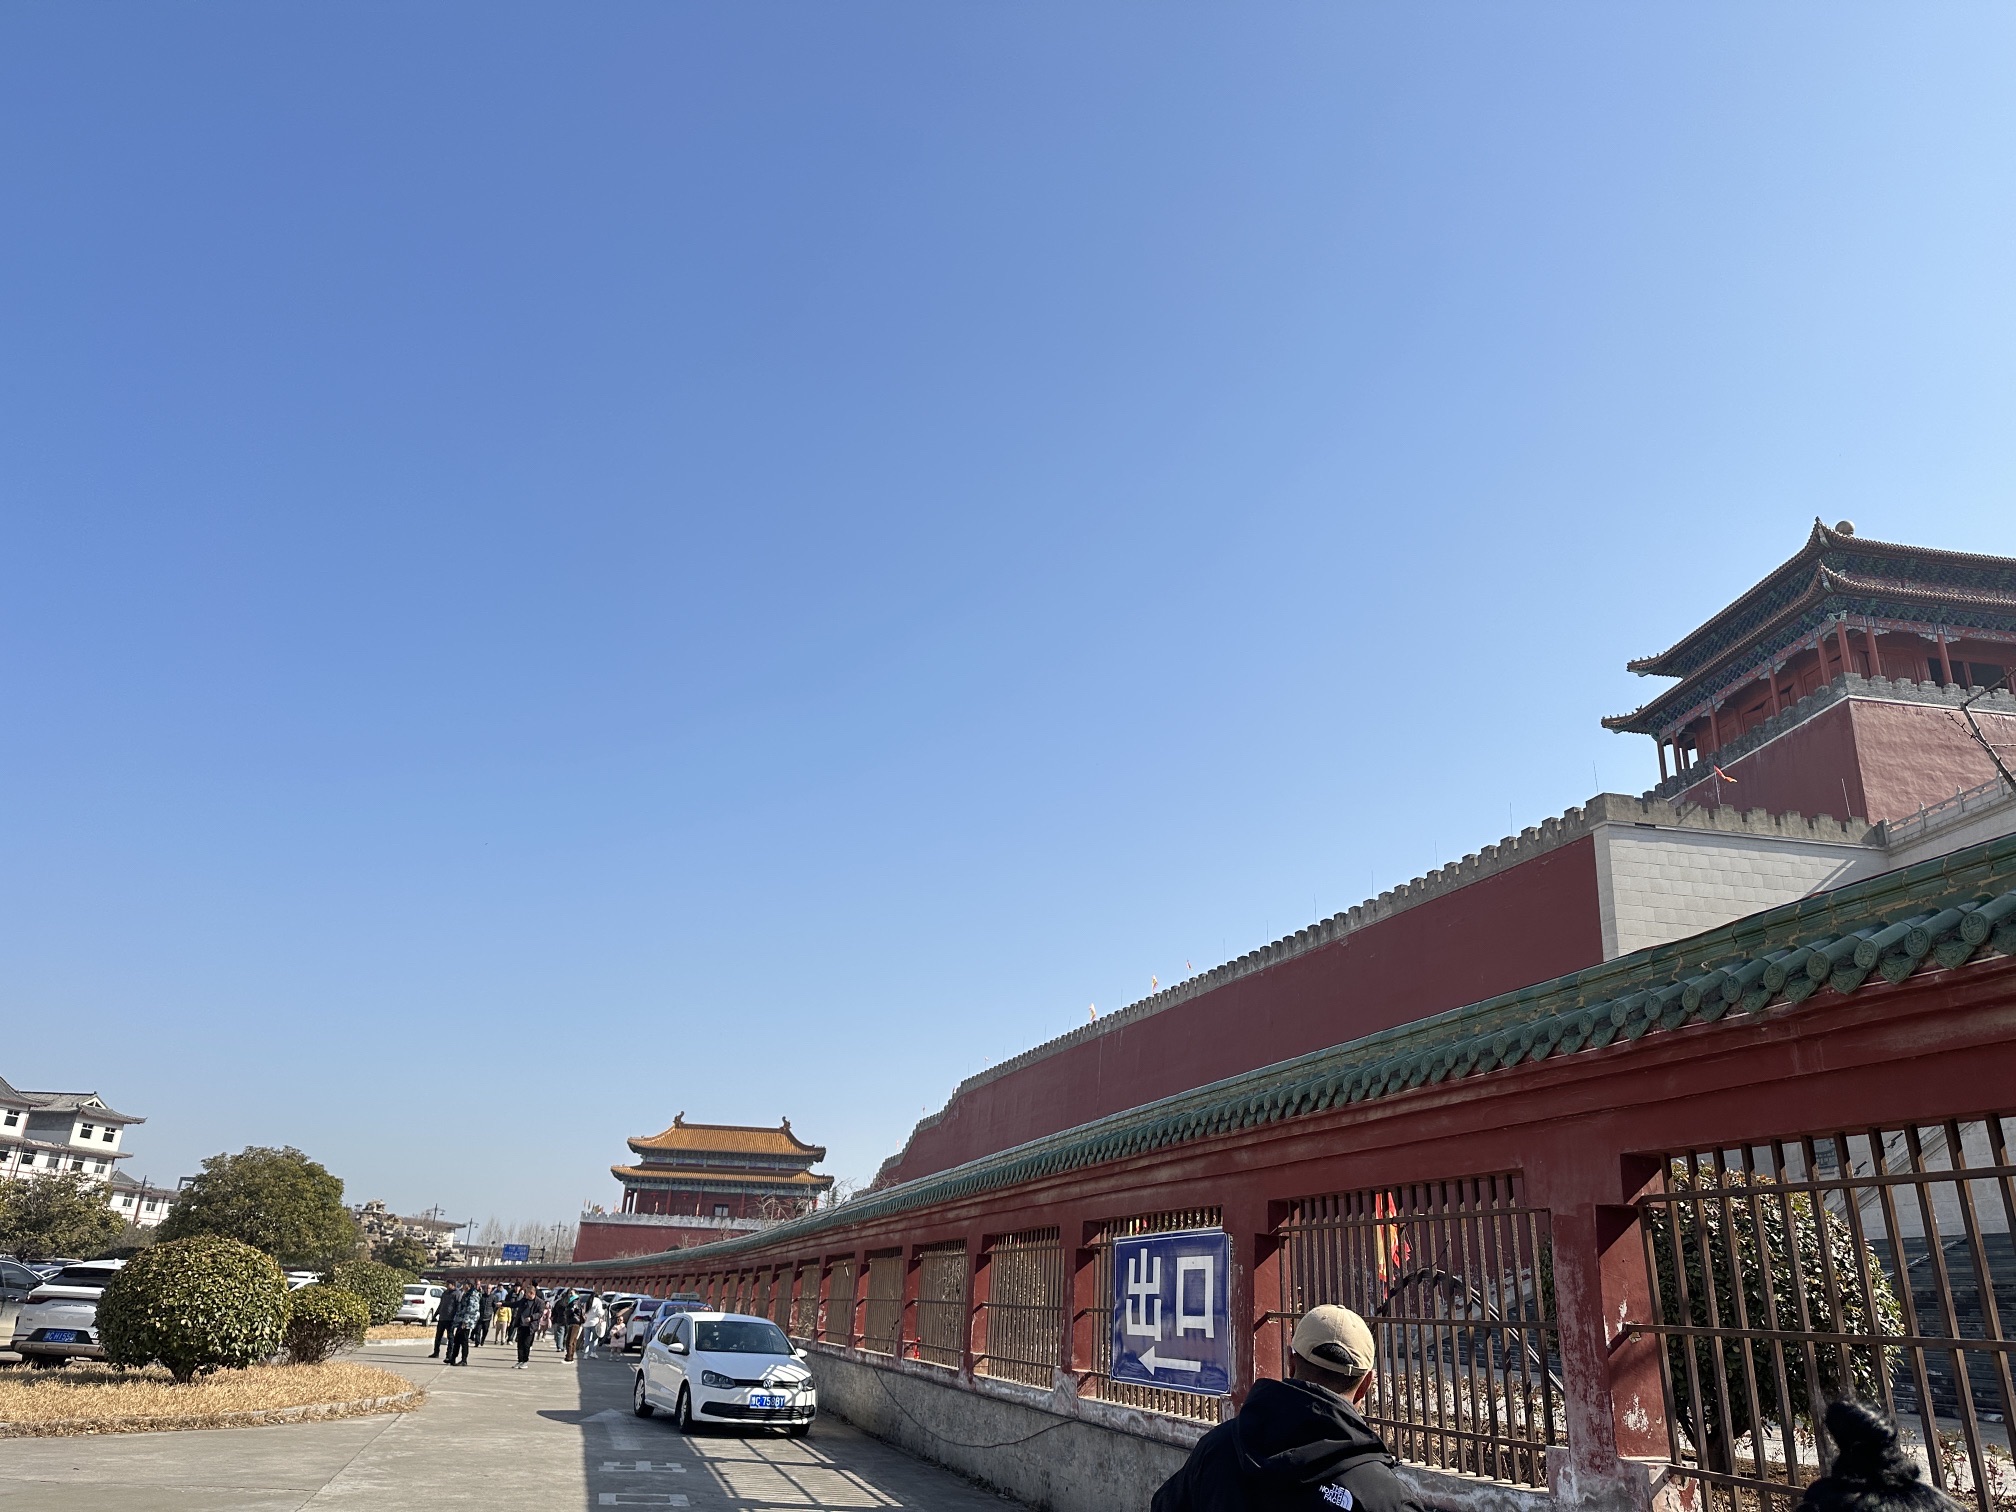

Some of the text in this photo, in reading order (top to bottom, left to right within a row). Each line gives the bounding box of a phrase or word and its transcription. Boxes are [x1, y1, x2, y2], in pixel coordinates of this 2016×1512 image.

[1126, 1248, 1214, 1341] 出口
[1319, 1485, 1343, 1502] NORTH
[1323, 1494, 1341, 1506] FACE
